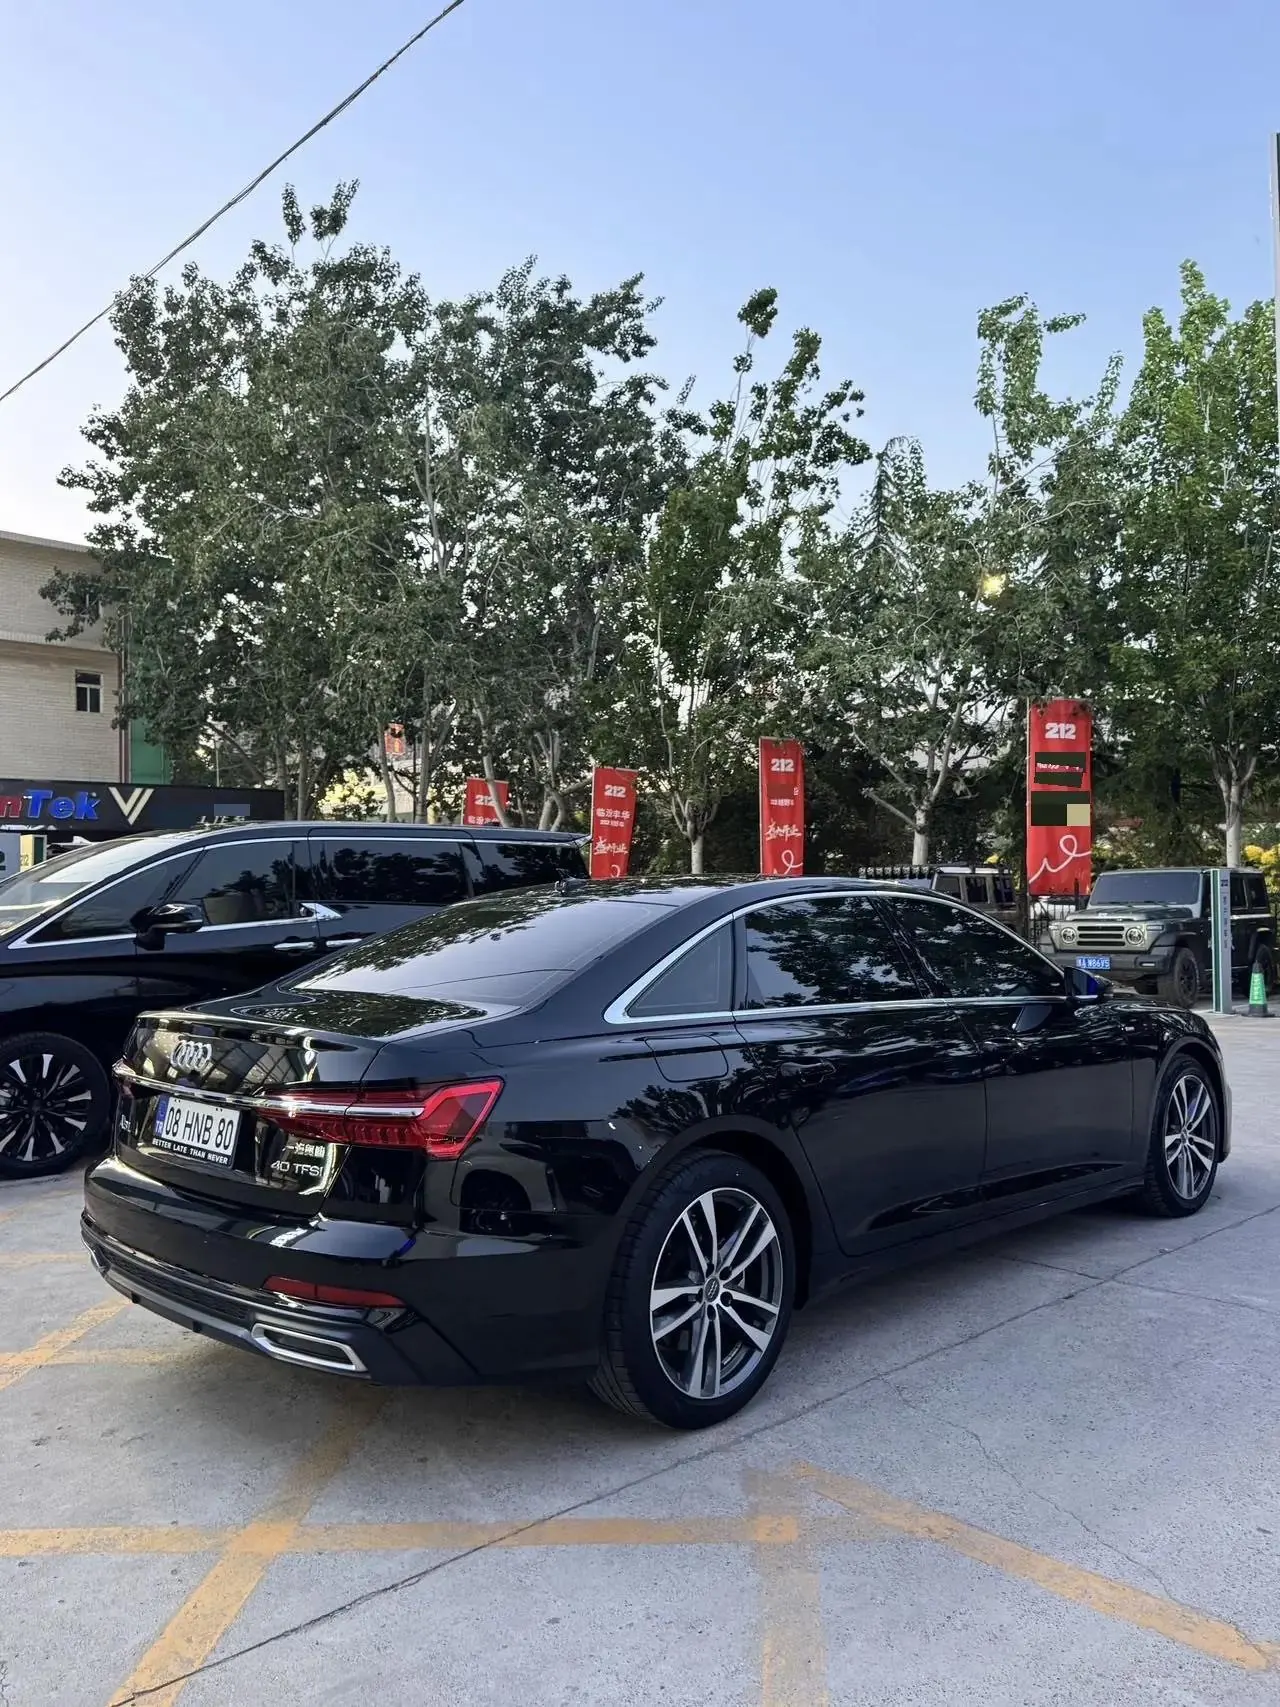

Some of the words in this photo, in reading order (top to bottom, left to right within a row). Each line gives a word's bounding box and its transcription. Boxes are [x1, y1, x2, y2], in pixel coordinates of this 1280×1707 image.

[1045, 723, 1076, 740] 212
[770, 758, 795, 772] 212
[604, 784, 627, 798] 212
[474, 794, 497, 807] 212
[155, 1120, 164, 1134] TR
[165, 1107, 182, 1137] 08
[182, 1110, 214, 1145] HNB
[215, 1118, 234, 1150] 80
[152, 1137, 172, 1149] BETTER
[172, 1143, 188, 1154] LATE
[189, 1148, 206, 1159] THAN
[207, 1152, 228, 1165] NEVER
[270, 1160, 290, 1172] 40
[292, 1163, 324, 1177] TFSI
